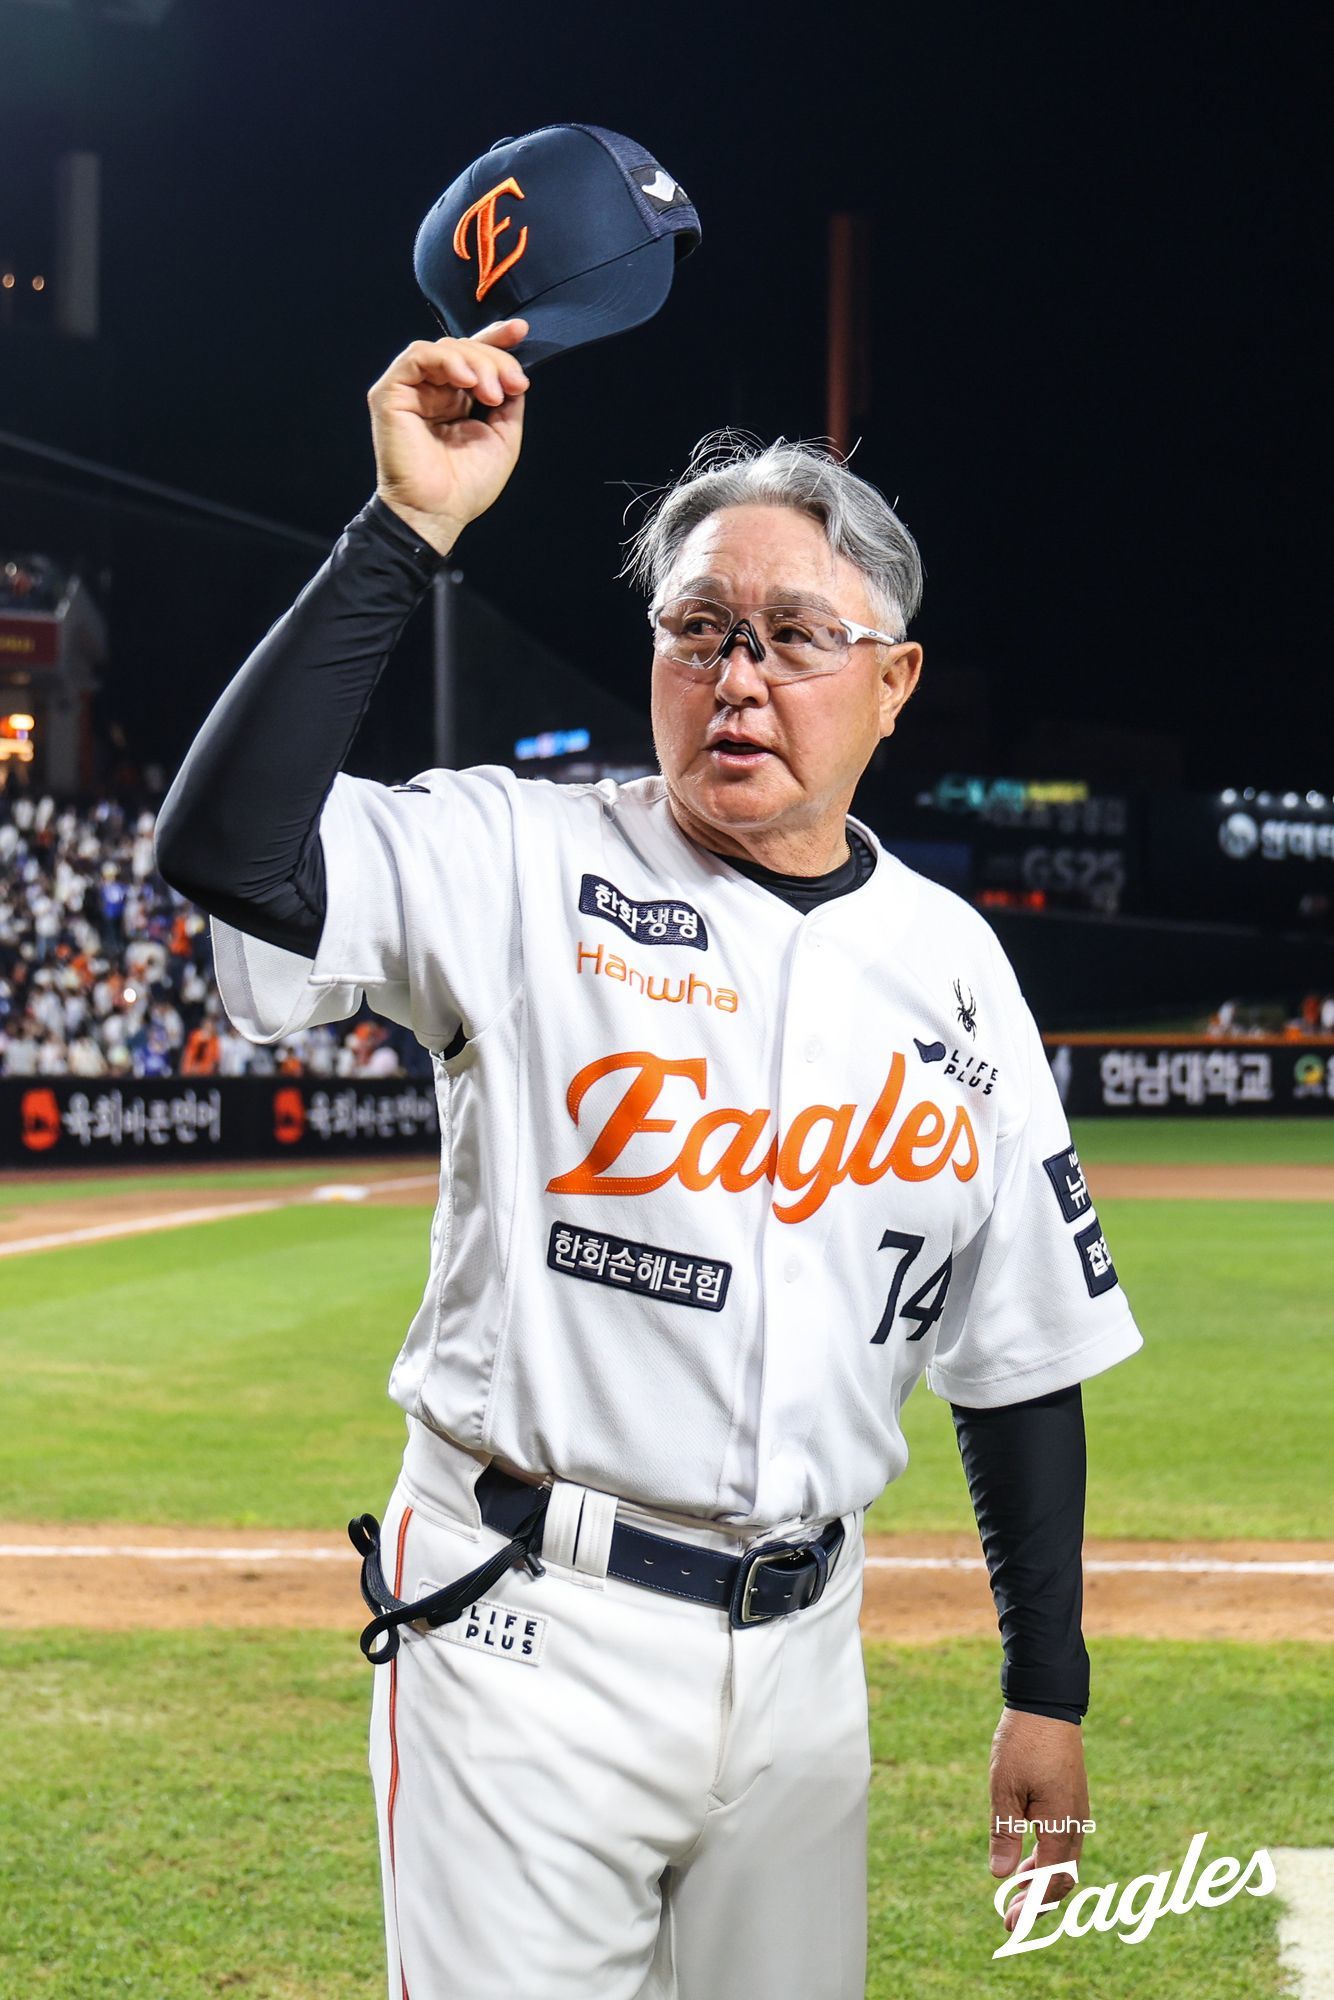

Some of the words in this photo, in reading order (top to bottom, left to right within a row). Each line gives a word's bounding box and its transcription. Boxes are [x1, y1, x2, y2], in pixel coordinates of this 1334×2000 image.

[594, 884, 699, 939] 한화생명
[576, 941, 739, 1014] Hanwha
[943, 1063, 994, 1095] PLUS
[951, 1049, 998, 1081] LIFE
[1100, 1050, 1273, 1105] 한남대학교
[545, 1051, 980, 1225] Eagles
[554, 1229, 726, 1303] 한화손해보험
[868, 1229, 954, 1345] 74
[465, 1623, 533, 1655] PLUS
[470, 1604, 537, 1637] LIFE
